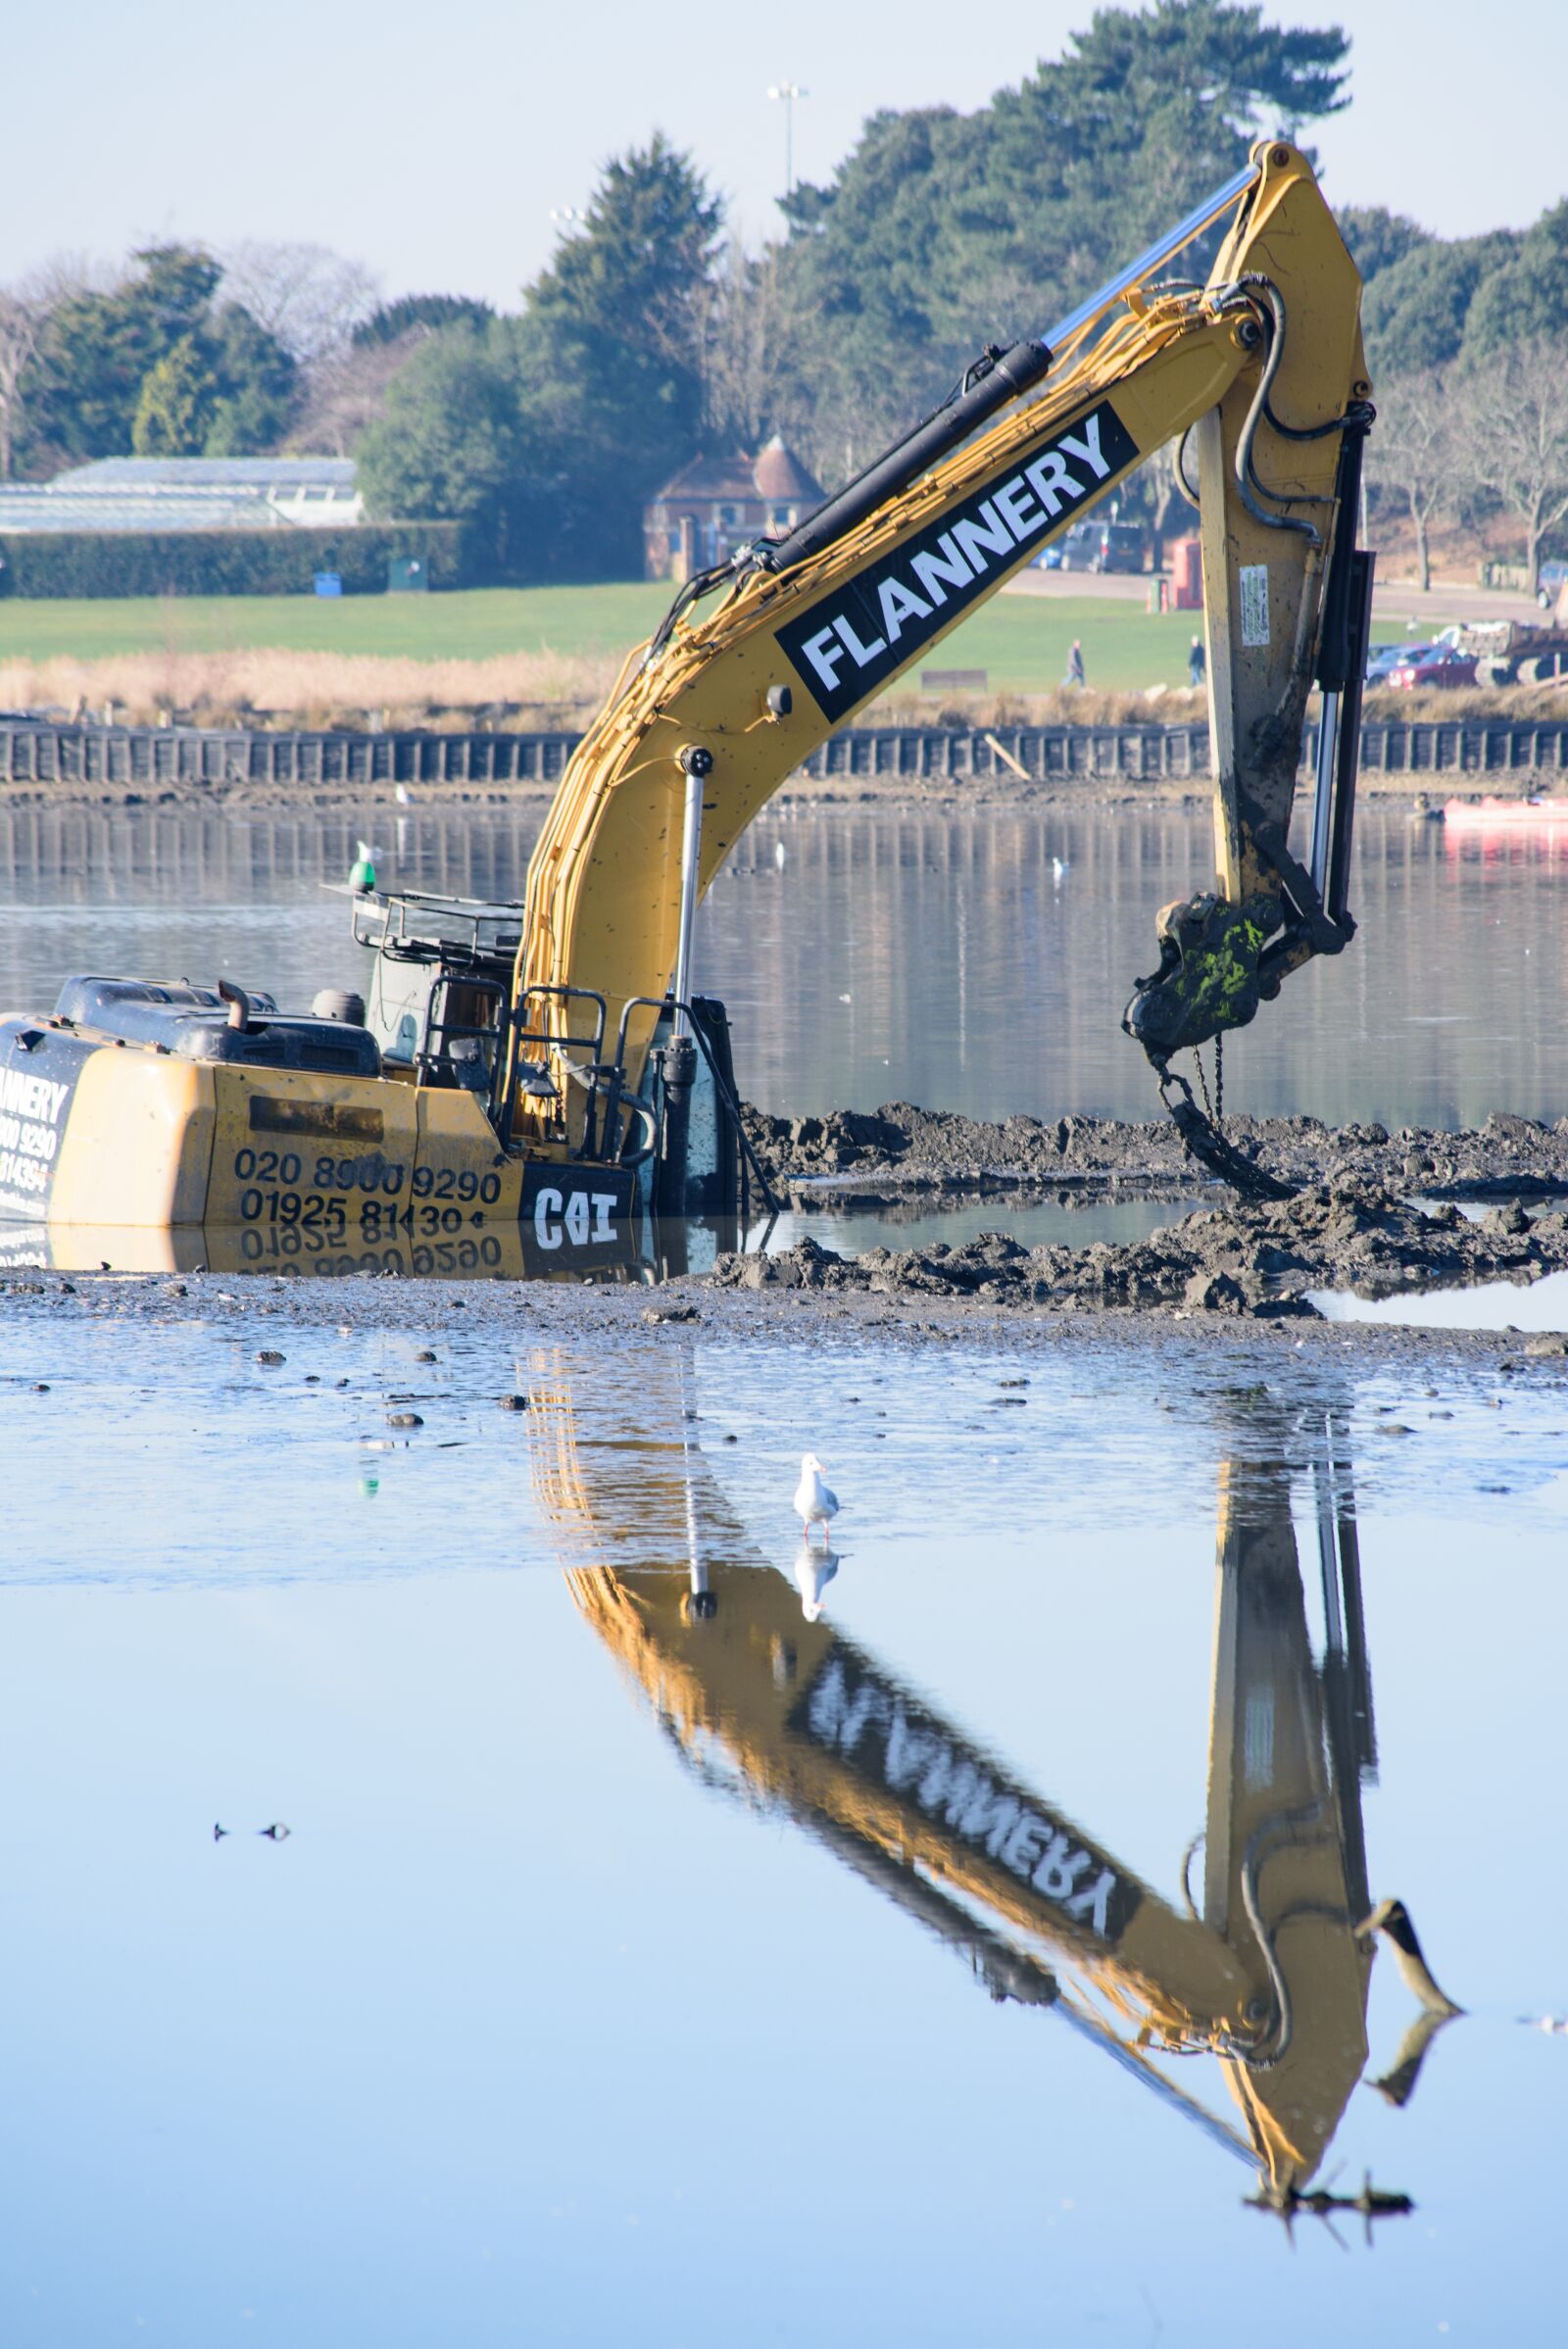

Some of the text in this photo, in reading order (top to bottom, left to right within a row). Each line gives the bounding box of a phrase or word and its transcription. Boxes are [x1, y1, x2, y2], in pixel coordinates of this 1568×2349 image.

[801, 413, 1110, 692] FLANNERY
[20, 1123, 57, 1160] 9290
[235, 1149, 502, 1204] 020 8900 9290
[241, 1189, 346, 1224] 01925
[534, 1188, 617, 1218] CAT
